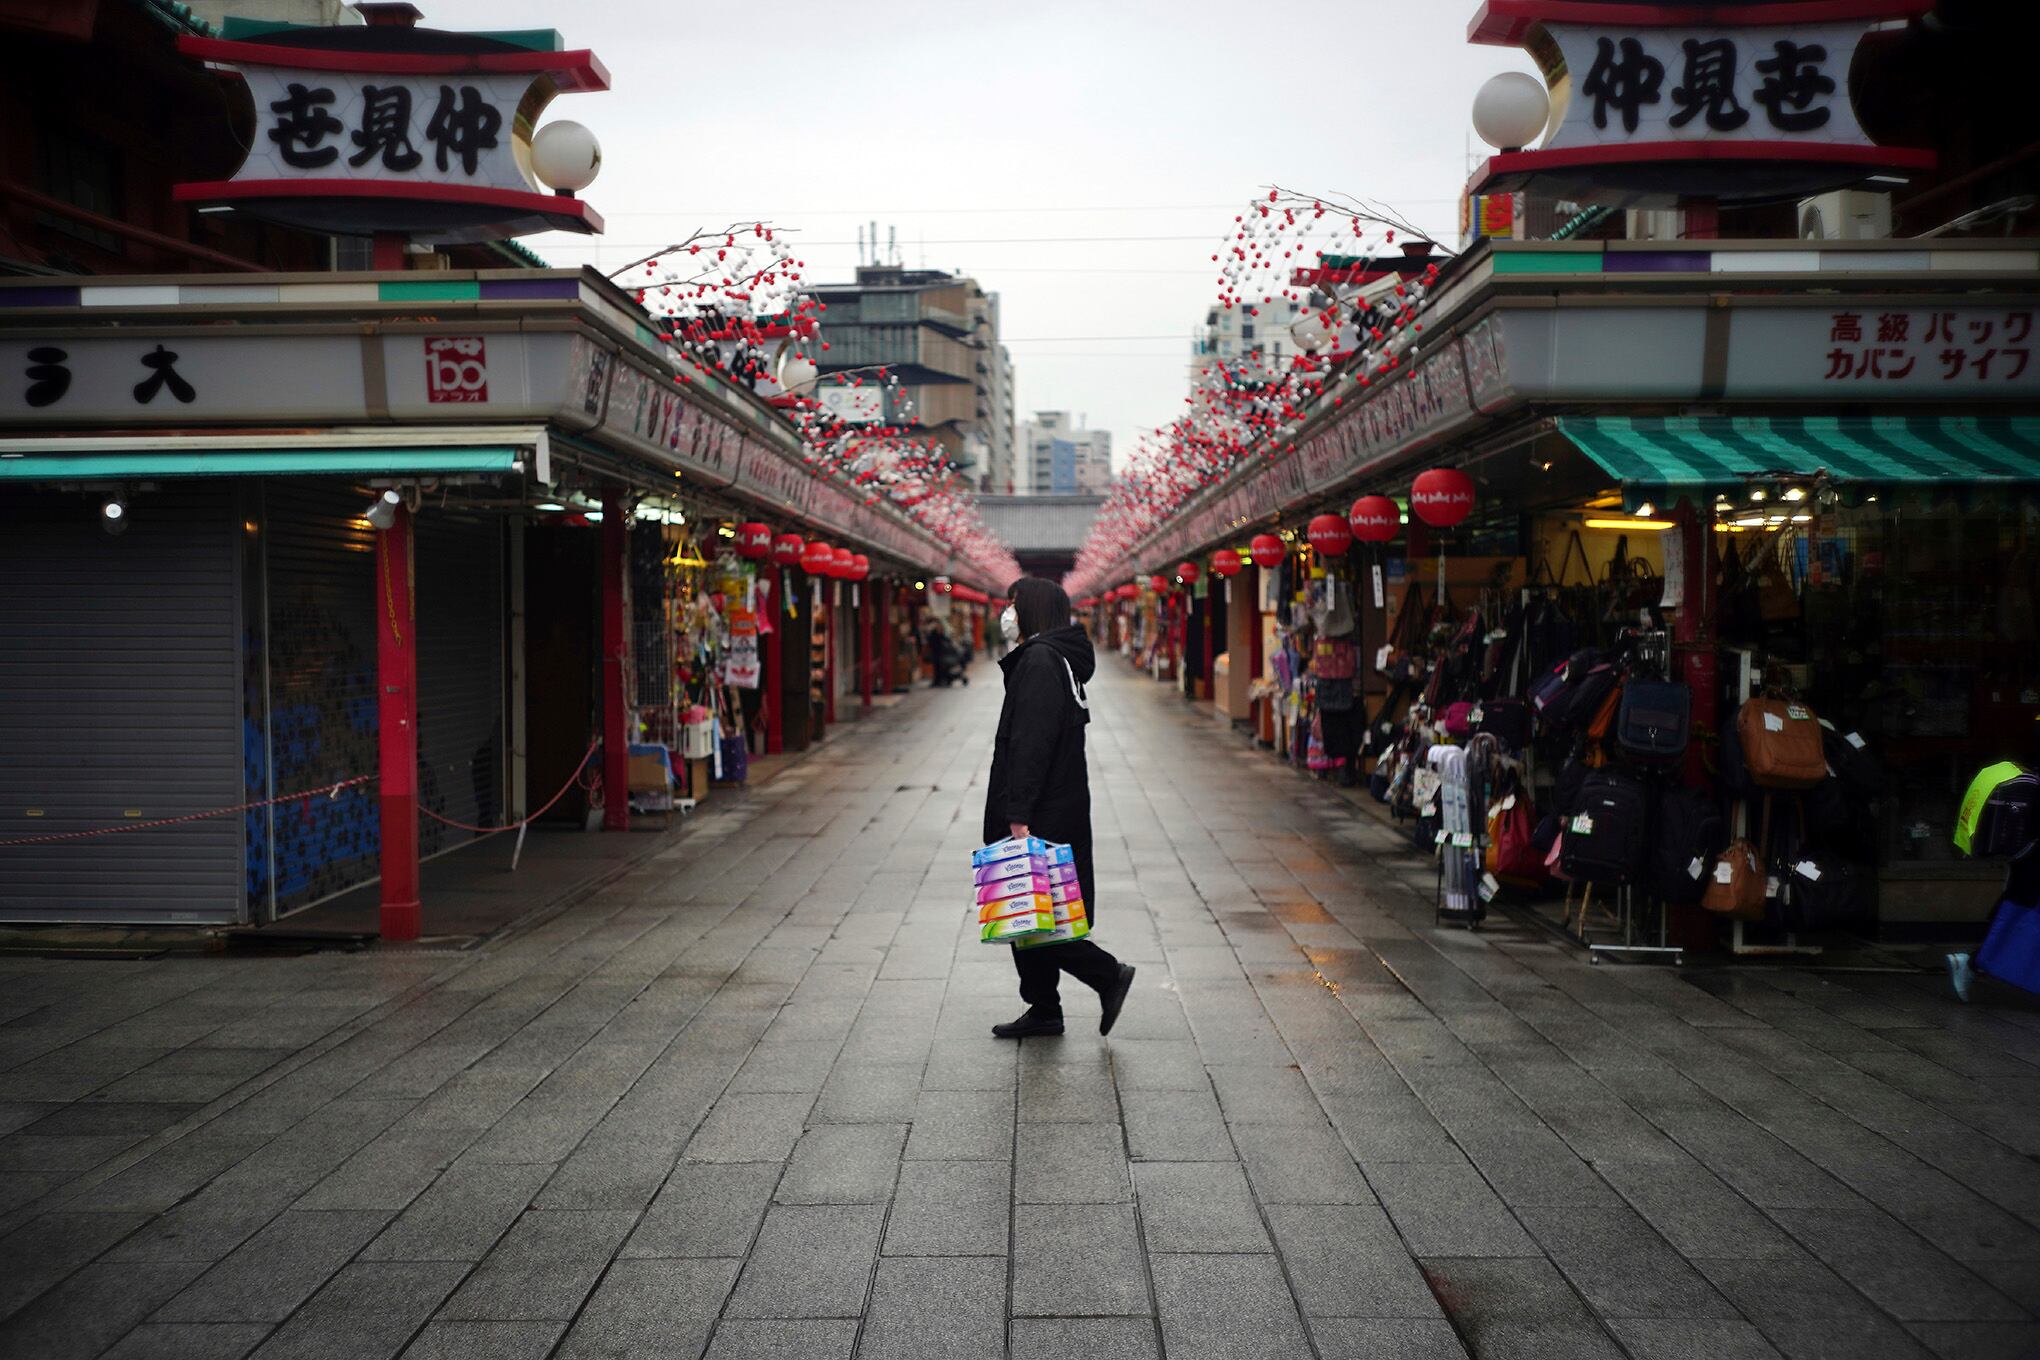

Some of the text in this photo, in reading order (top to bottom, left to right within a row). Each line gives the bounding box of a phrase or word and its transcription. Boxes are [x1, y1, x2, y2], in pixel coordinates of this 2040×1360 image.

[1824, 348, 2031, 380] カバン サイフ
